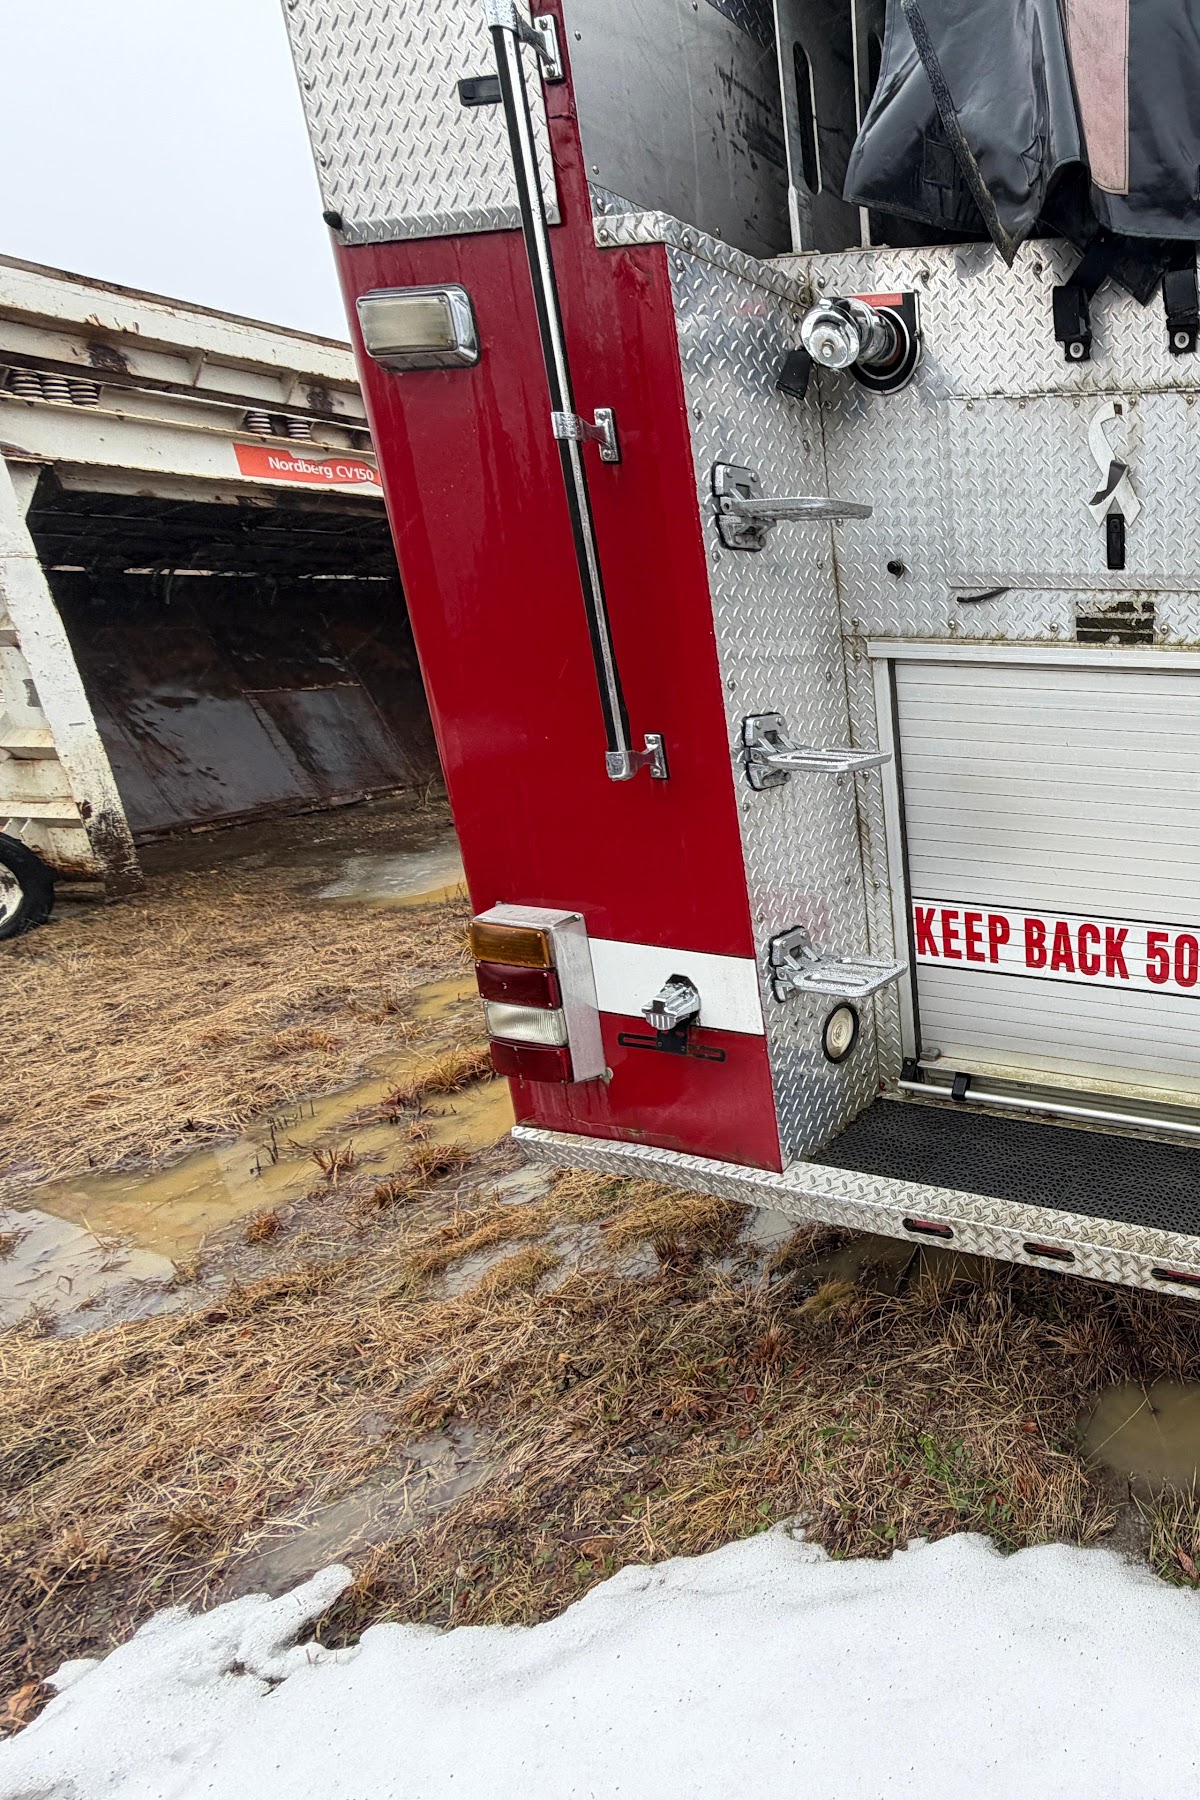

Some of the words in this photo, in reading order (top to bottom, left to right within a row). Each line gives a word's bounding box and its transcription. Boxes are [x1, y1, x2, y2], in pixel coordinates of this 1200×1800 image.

[268, 456, 334, 478] Nordberg
[336, 465, 375, 481] CV150
[914, 906, 1011, 963] KEEP
[1024, 917, 1130, 980] BACK
